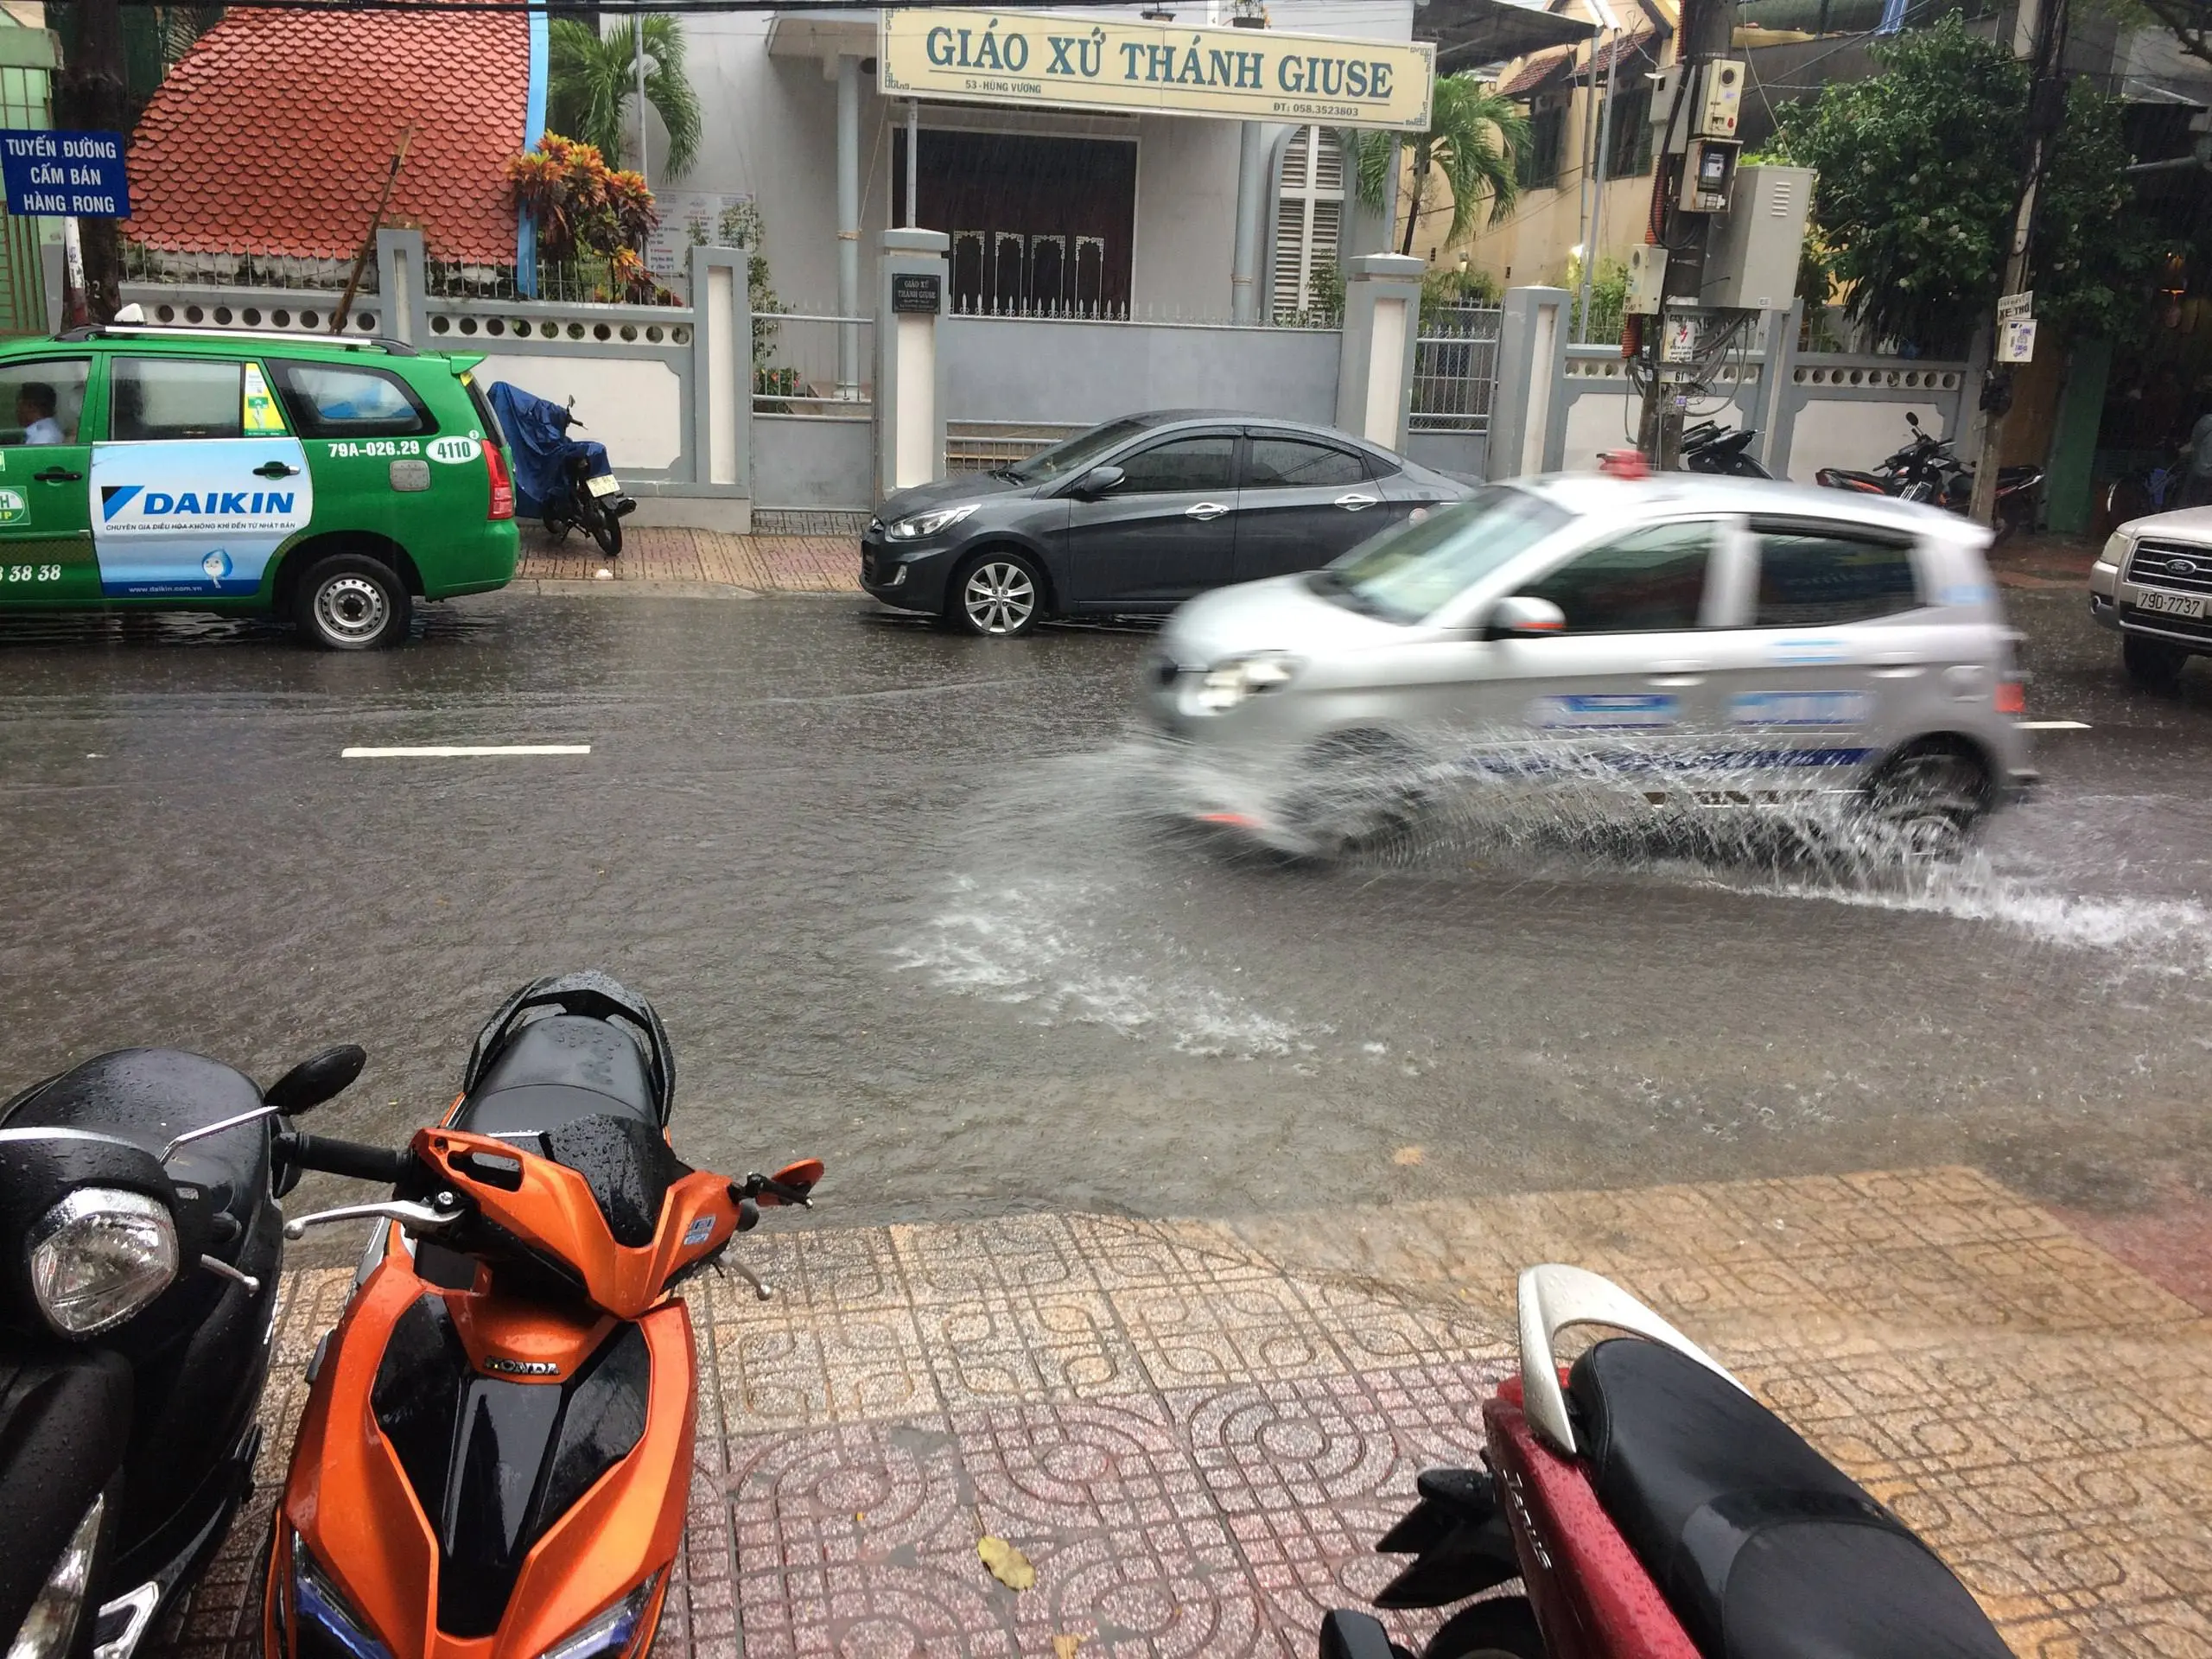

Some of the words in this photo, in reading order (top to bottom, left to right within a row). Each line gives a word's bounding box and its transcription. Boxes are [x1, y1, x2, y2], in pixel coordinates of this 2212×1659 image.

[926, 17, 1029, 72] GIÁO
[1046, 27, 1107, 78] XỨ
[1119, 34, 1264, 89] THÁNH
[1278, 54, 1393, 99] GIUSE
[1293, 104, 1359, 117] 058.3523803
[5, 135, 57, 156] TUYẾN
[63, 137, 117, 159] ĐƯỜNG
[30, 162, 64, 184] CẤM
[70, 164, 101, 185] BÁN
[23, 191, 67, 211] HÀNG
[73, 195, 115, 213] RONG
[327, 440, 421, 458] 79A-026.29
[437, 441, 471, 459] 4110
[143, 493, 295, 515] DAIKIN
[9, 565, 33, 582] 38
[37, 564, 61, 582] 38
[129, 584, 202, 593] www.daikin.com.vn
[2140, 592, 2200, 615] 79D-7737
[485, 1357, 560, 1375] HONDA
